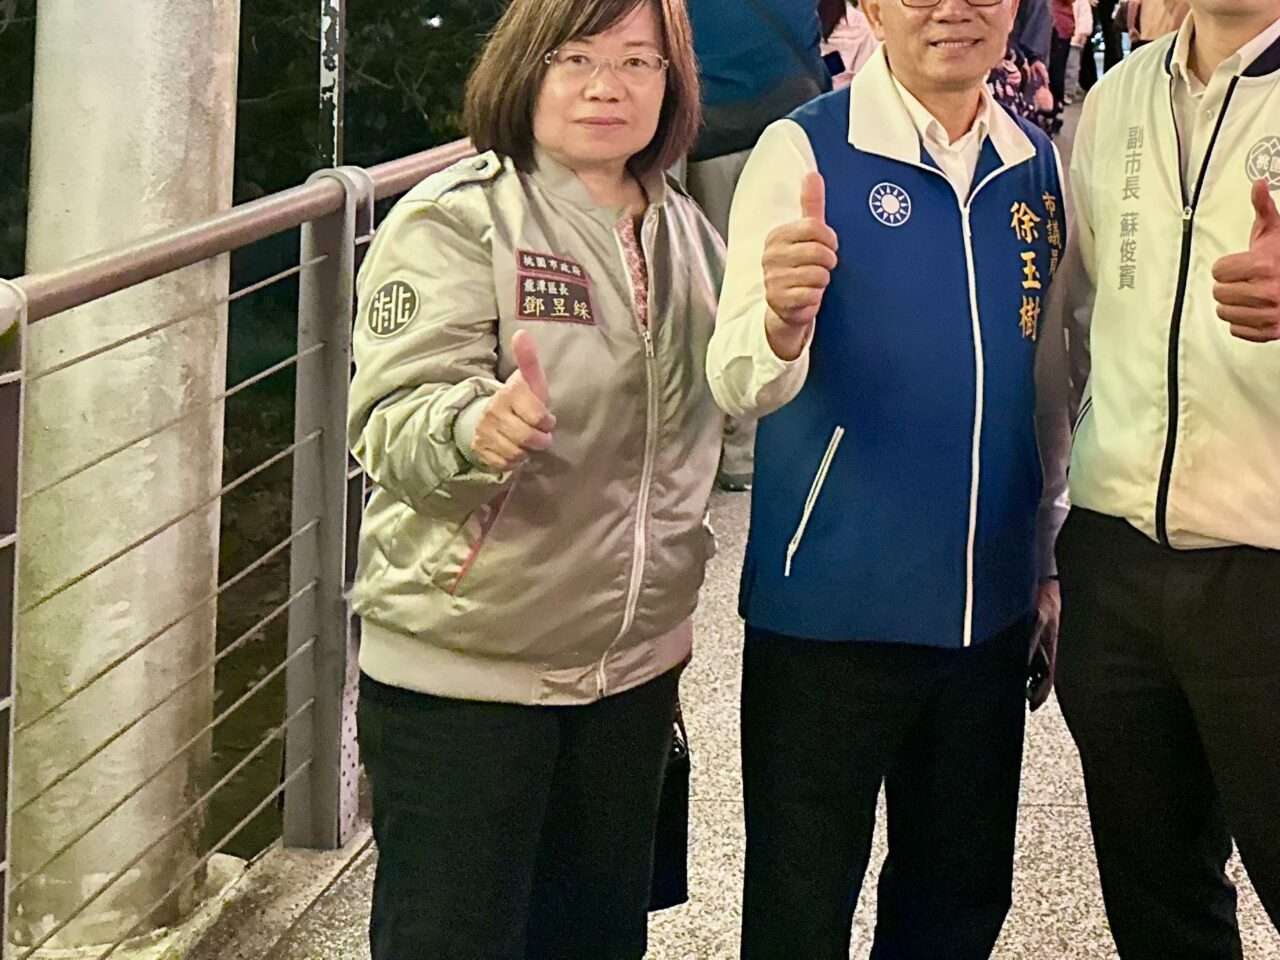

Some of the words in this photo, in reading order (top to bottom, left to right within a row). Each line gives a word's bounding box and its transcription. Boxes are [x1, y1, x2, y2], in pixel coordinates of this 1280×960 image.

[1121, 125, 1145, 201] 副市長
[1009, 200, 1043, 342] 徐玉樹
[1117, 211, 1140, 290] 蘇俊賓
[522, 295, 592, 320] 鄧昱綵
